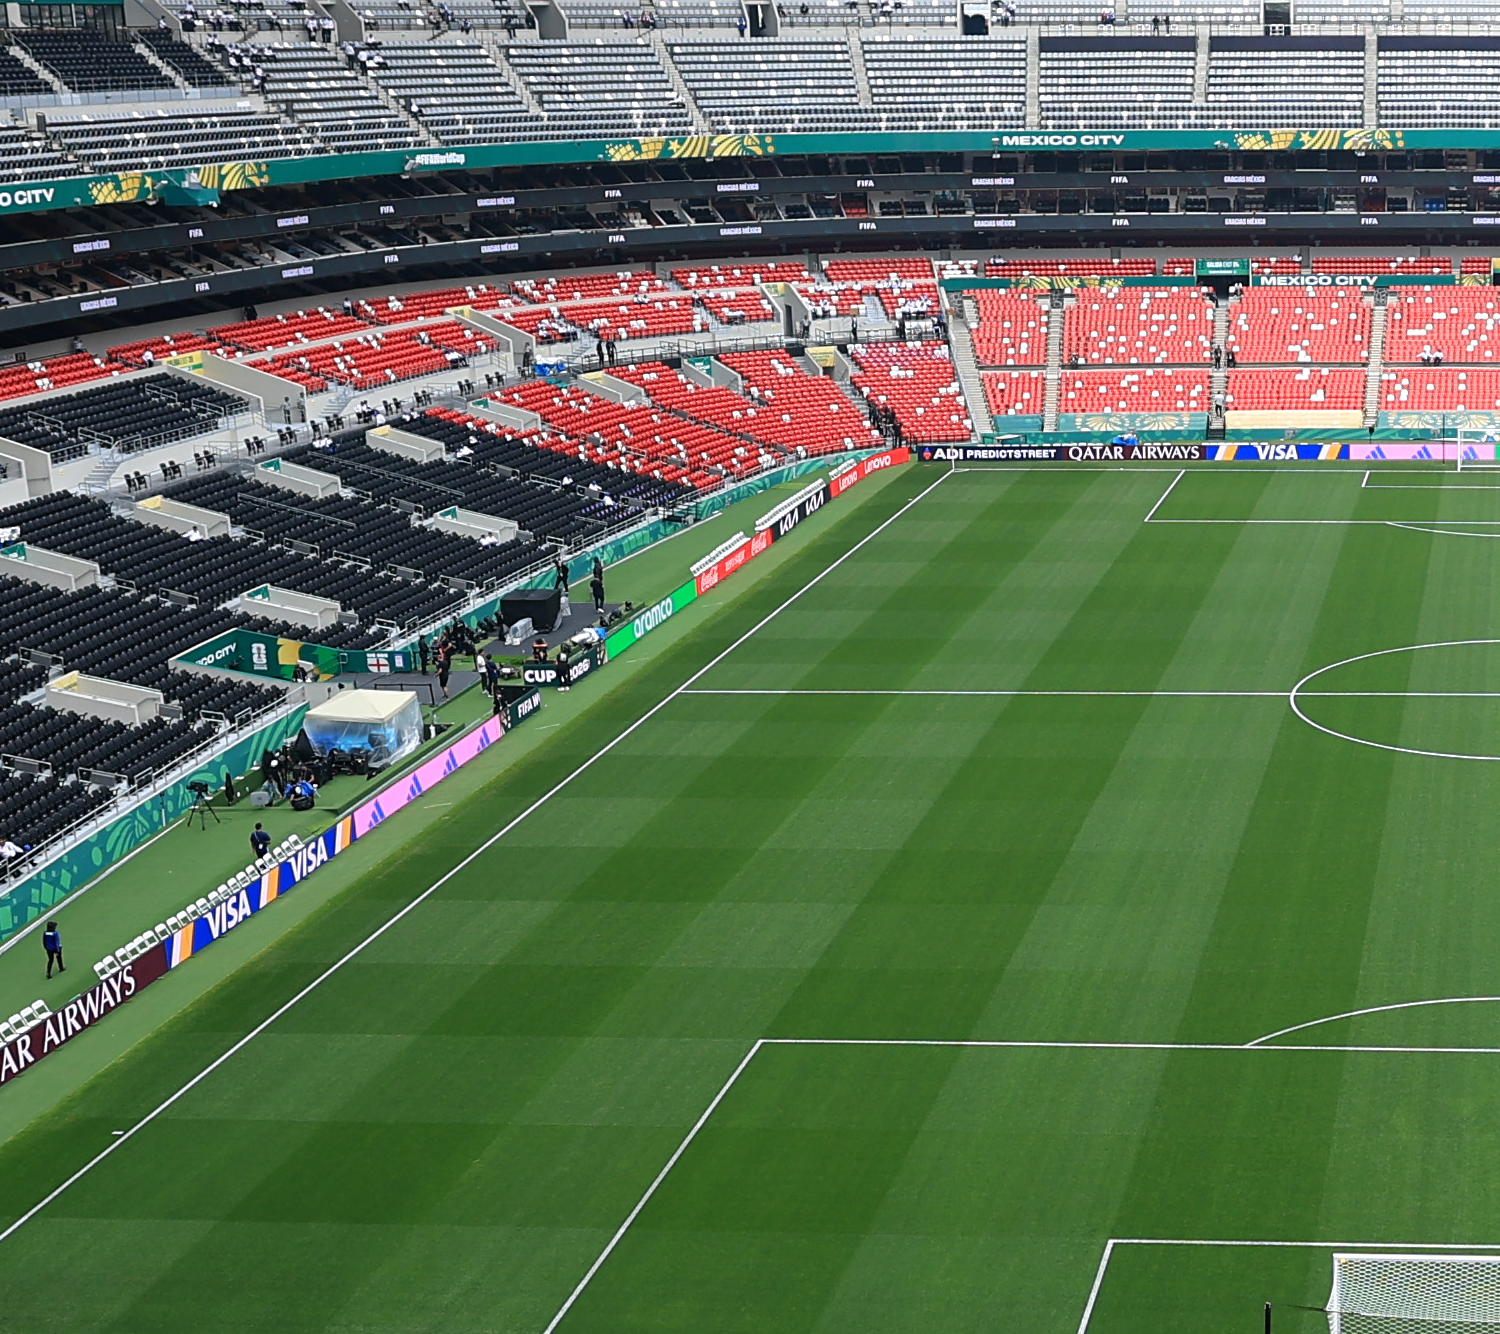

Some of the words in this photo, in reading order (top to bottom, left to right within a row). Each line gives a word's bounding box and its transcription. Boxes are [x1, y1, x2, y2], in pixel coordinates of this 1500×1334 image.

[1002, 135, 1075, 147] MEXICO
[1079, 134, 1125, 147] CITY
[12, 188, 54, 206] CITY
[1260, 275, 1330, 286] MEXICO
[1334, 275, 1378, 286] CITY
[933, 448, 964, 459] ADI
[966, 449, 1057, 459] PREDICTSTREET
[1068, 445, 1124, 460] QATAR
[1130, 446, 1200, 459] AIRWAYS
[1253, 444, 1299, 460] VISA
[864, 454, 892, 473] Lenovo
[838, 470, 858, 491] Lenovo
[634, 596, 673, 638] aramco
[215, 642, 237, 660] CITY
[524, 669, 557, 683] CUP
[518, 697, 534, 718] FIFA
[288, 841, 329, 882] VISA
[205, 890, 252, 940] VISA
[43, 965, 137, 1053] AIRWAYS
